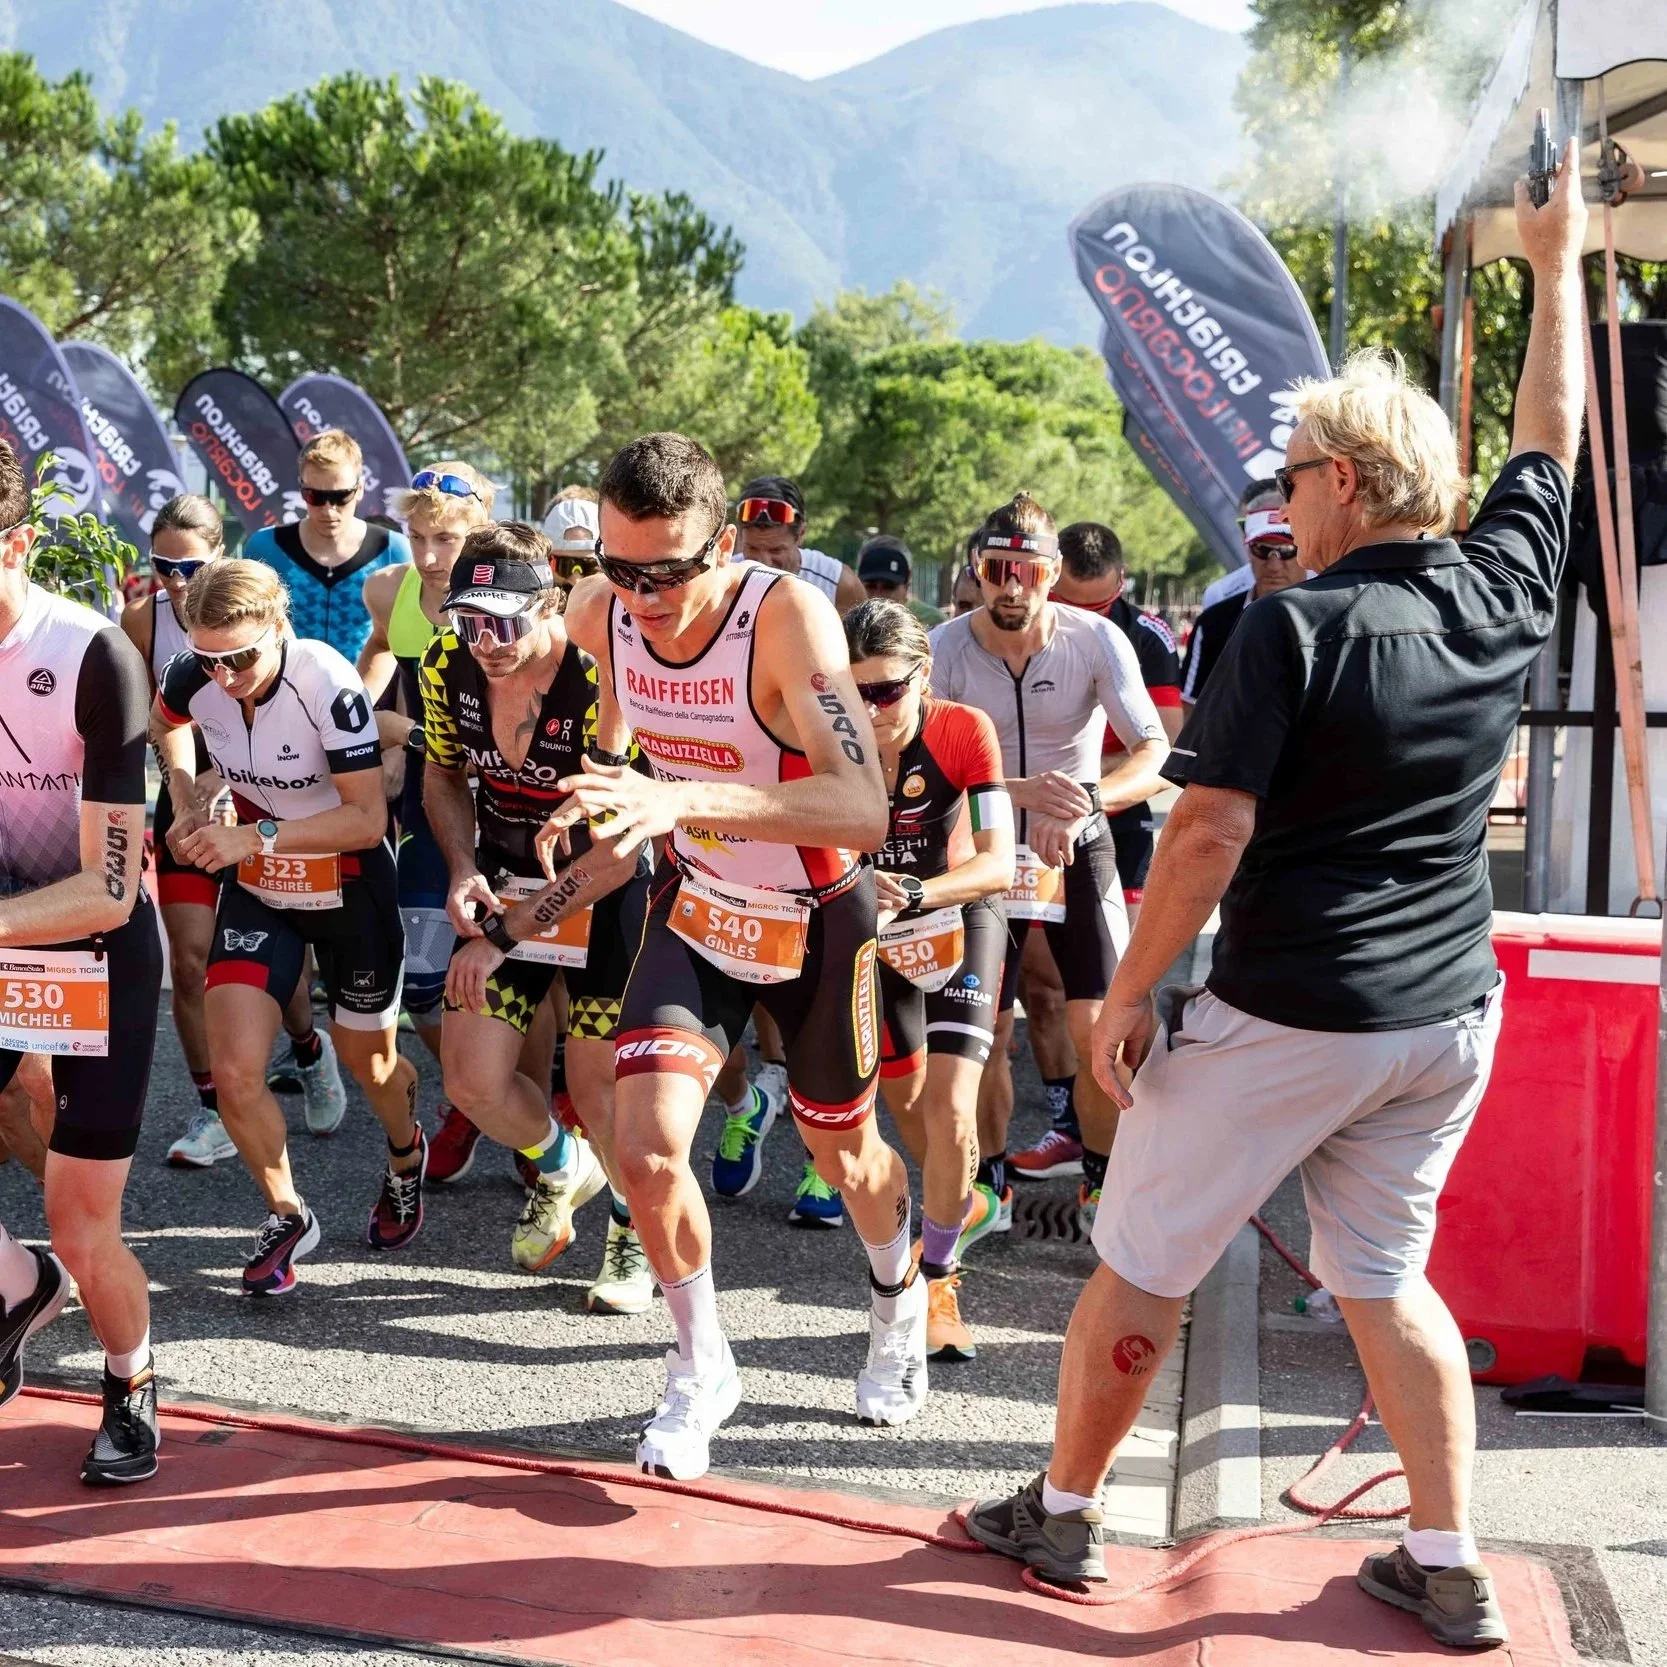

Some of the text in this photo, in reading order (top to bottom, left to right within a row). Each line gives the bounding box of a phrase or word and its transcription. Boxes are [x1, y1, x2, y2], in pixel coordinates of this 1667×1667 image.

[626, 667, 734, 705] RAIFFEISEN
[645, 705, 674, 718] Raiffeisen
[674, 710, 689, 720] della
[816, 693, 866, 766] 540
[540, 740, 572, 753] SUUNTO
[637, 734, 737, 766] MARUZZELLA
[228, 767, 320, 790] bikebox
[106, 826, 128, 902] 530
[263, 857, 307, 879] 523
[260, 877, 313, 892] DESIRÉE
[747, 902, 780, 911] MIGROS
[781, 905, 807, 915] TICINO
[707, 907, 763, 943] 540
[704, 933, 757, 960] GILLES
[886, 940, 935, 968] 550
[46, 966, 77, 974] MIGROS
[79, 966, 105, 974] TICINO
[901, 961, 938, 979] RIAM
[4, 982, 64, 1009] 530
[0, 1011, 72, 1028] MICHELE
[857, 946, 875, 1071] MARUZZELLA
[32, 1041, 59, 1051] unicef
